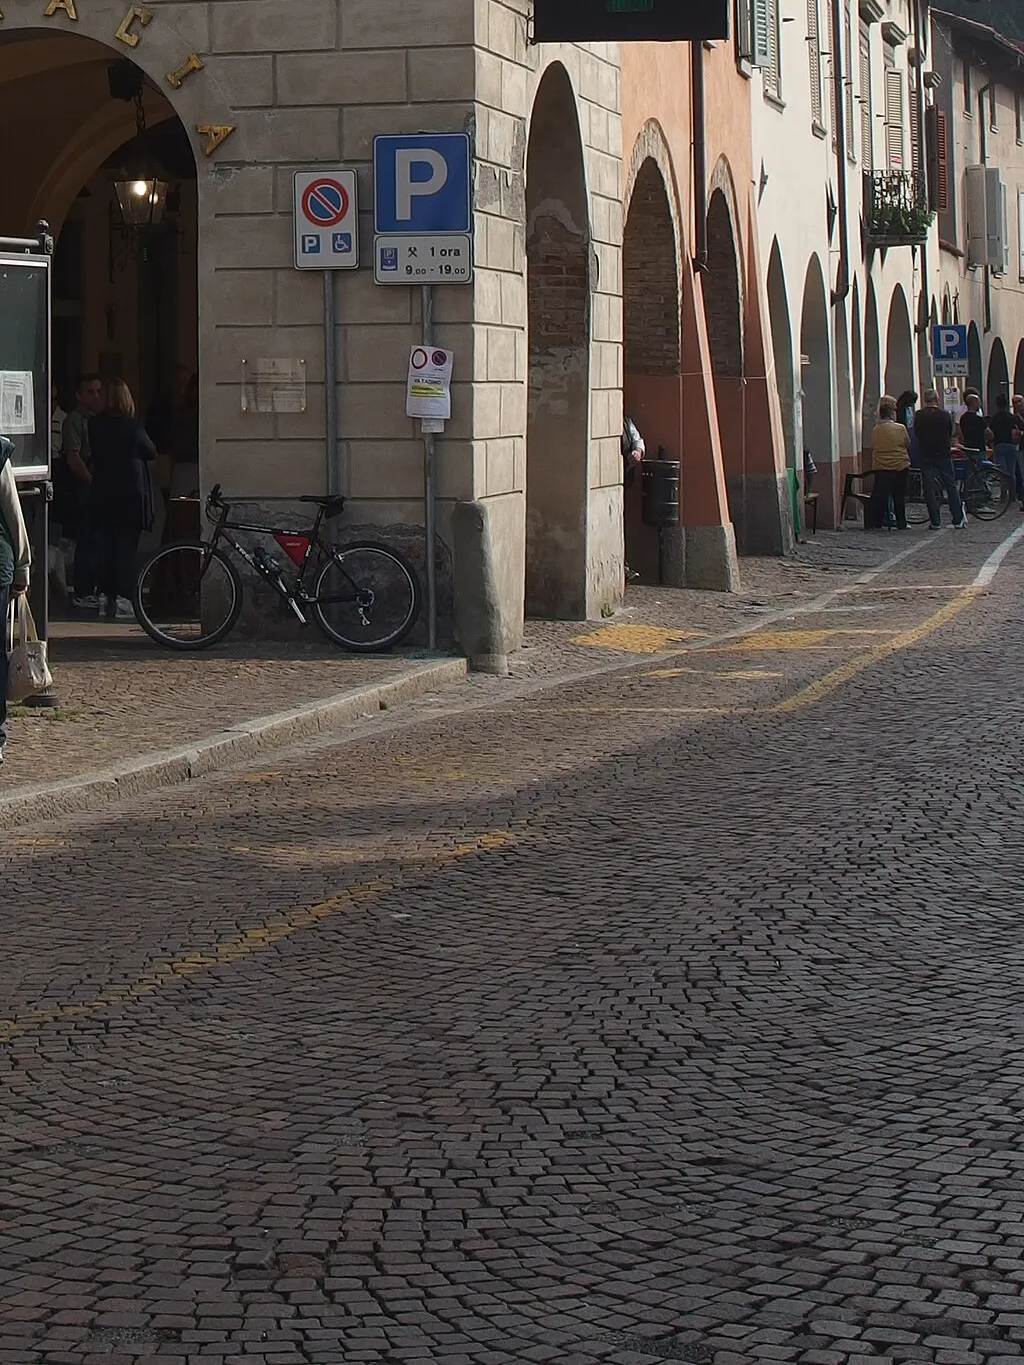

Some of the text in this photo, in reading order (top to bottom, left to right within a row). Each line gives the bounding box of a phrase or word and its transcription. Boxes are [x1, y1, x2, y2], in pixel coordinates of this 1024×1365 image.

[396, 148, 448, 221] P
[304, 236, 317, 252] P
[430, 247, 460, 256] 1 ora
[940, 330, 960, 355] P
